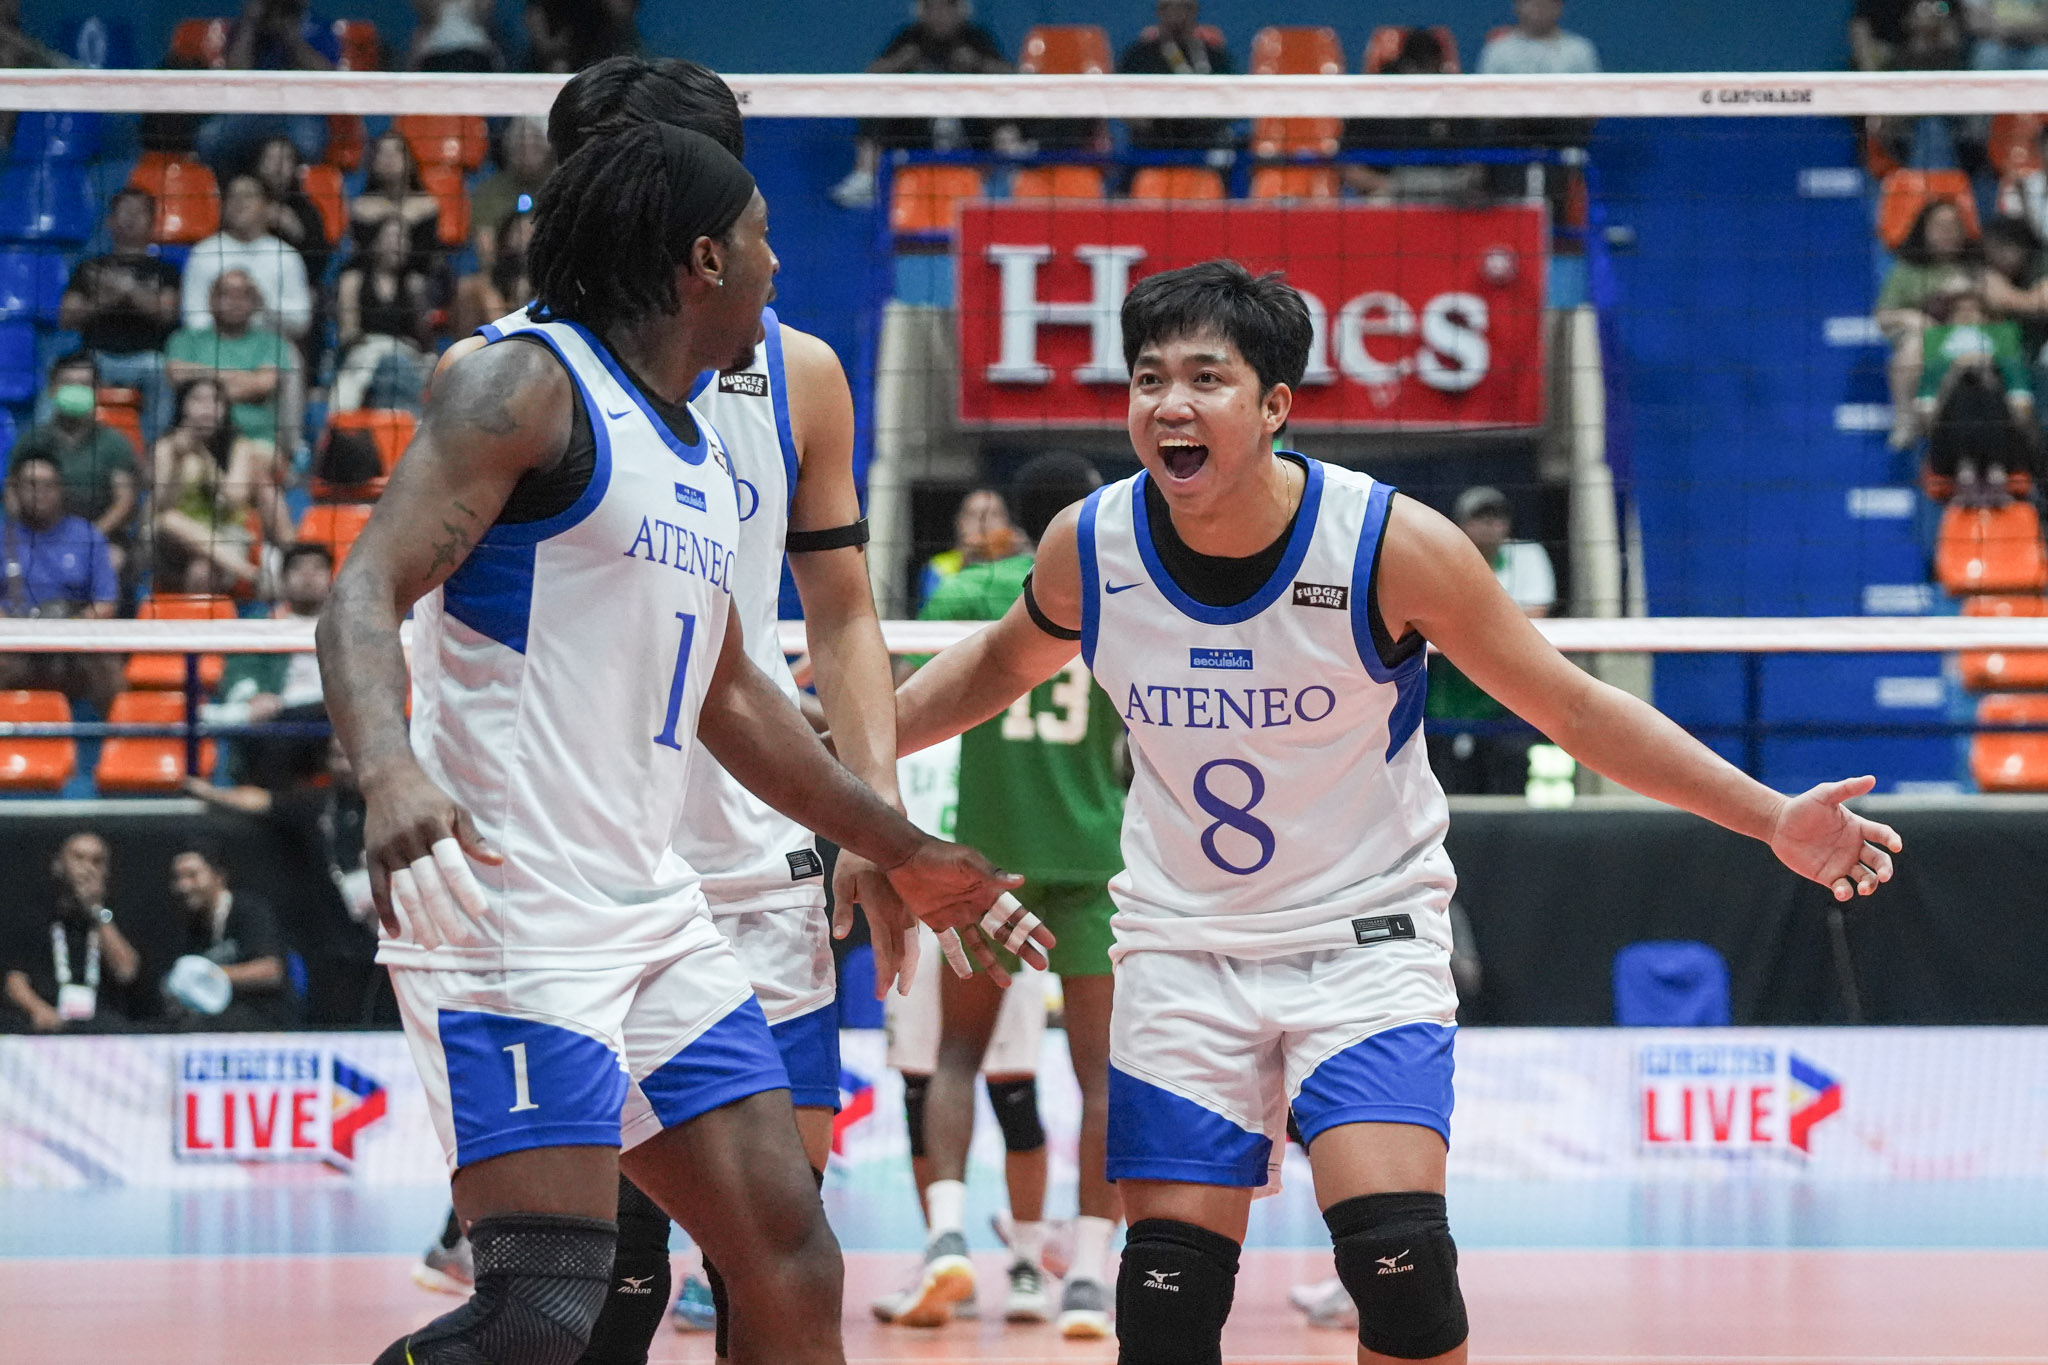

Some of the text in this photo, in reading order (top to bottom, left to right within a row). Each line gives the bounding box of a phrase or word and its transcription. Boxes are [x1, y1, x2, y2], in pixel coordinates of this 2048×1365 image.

[987, 244, 1490, 392] Hes
[720, 375, 764, 387] FUDGEE
[733, 383, 762, 395] BARR
[623, 515, 735, 594] ATENEO
[1296, 586, 1343, 600] FUDGEE
[1310, 595, 1340, 608] BARR
[653, 611, 696, 752] 1
[1193, 656, 1251, 668] seoulskin
[1125, 682, 1336, 729] ATENEO
[1193, 758, 1276, 876] 8
[503, 1042, 539, 1113] 1
[186, 1092, 318, 1149] LIVE
[1646, 1087, 1774, 1141] LIVE
[1143, 1279, 1179, 1292] MIZUNO
[1377, 1264, 1414, 1275] MIZUNO
